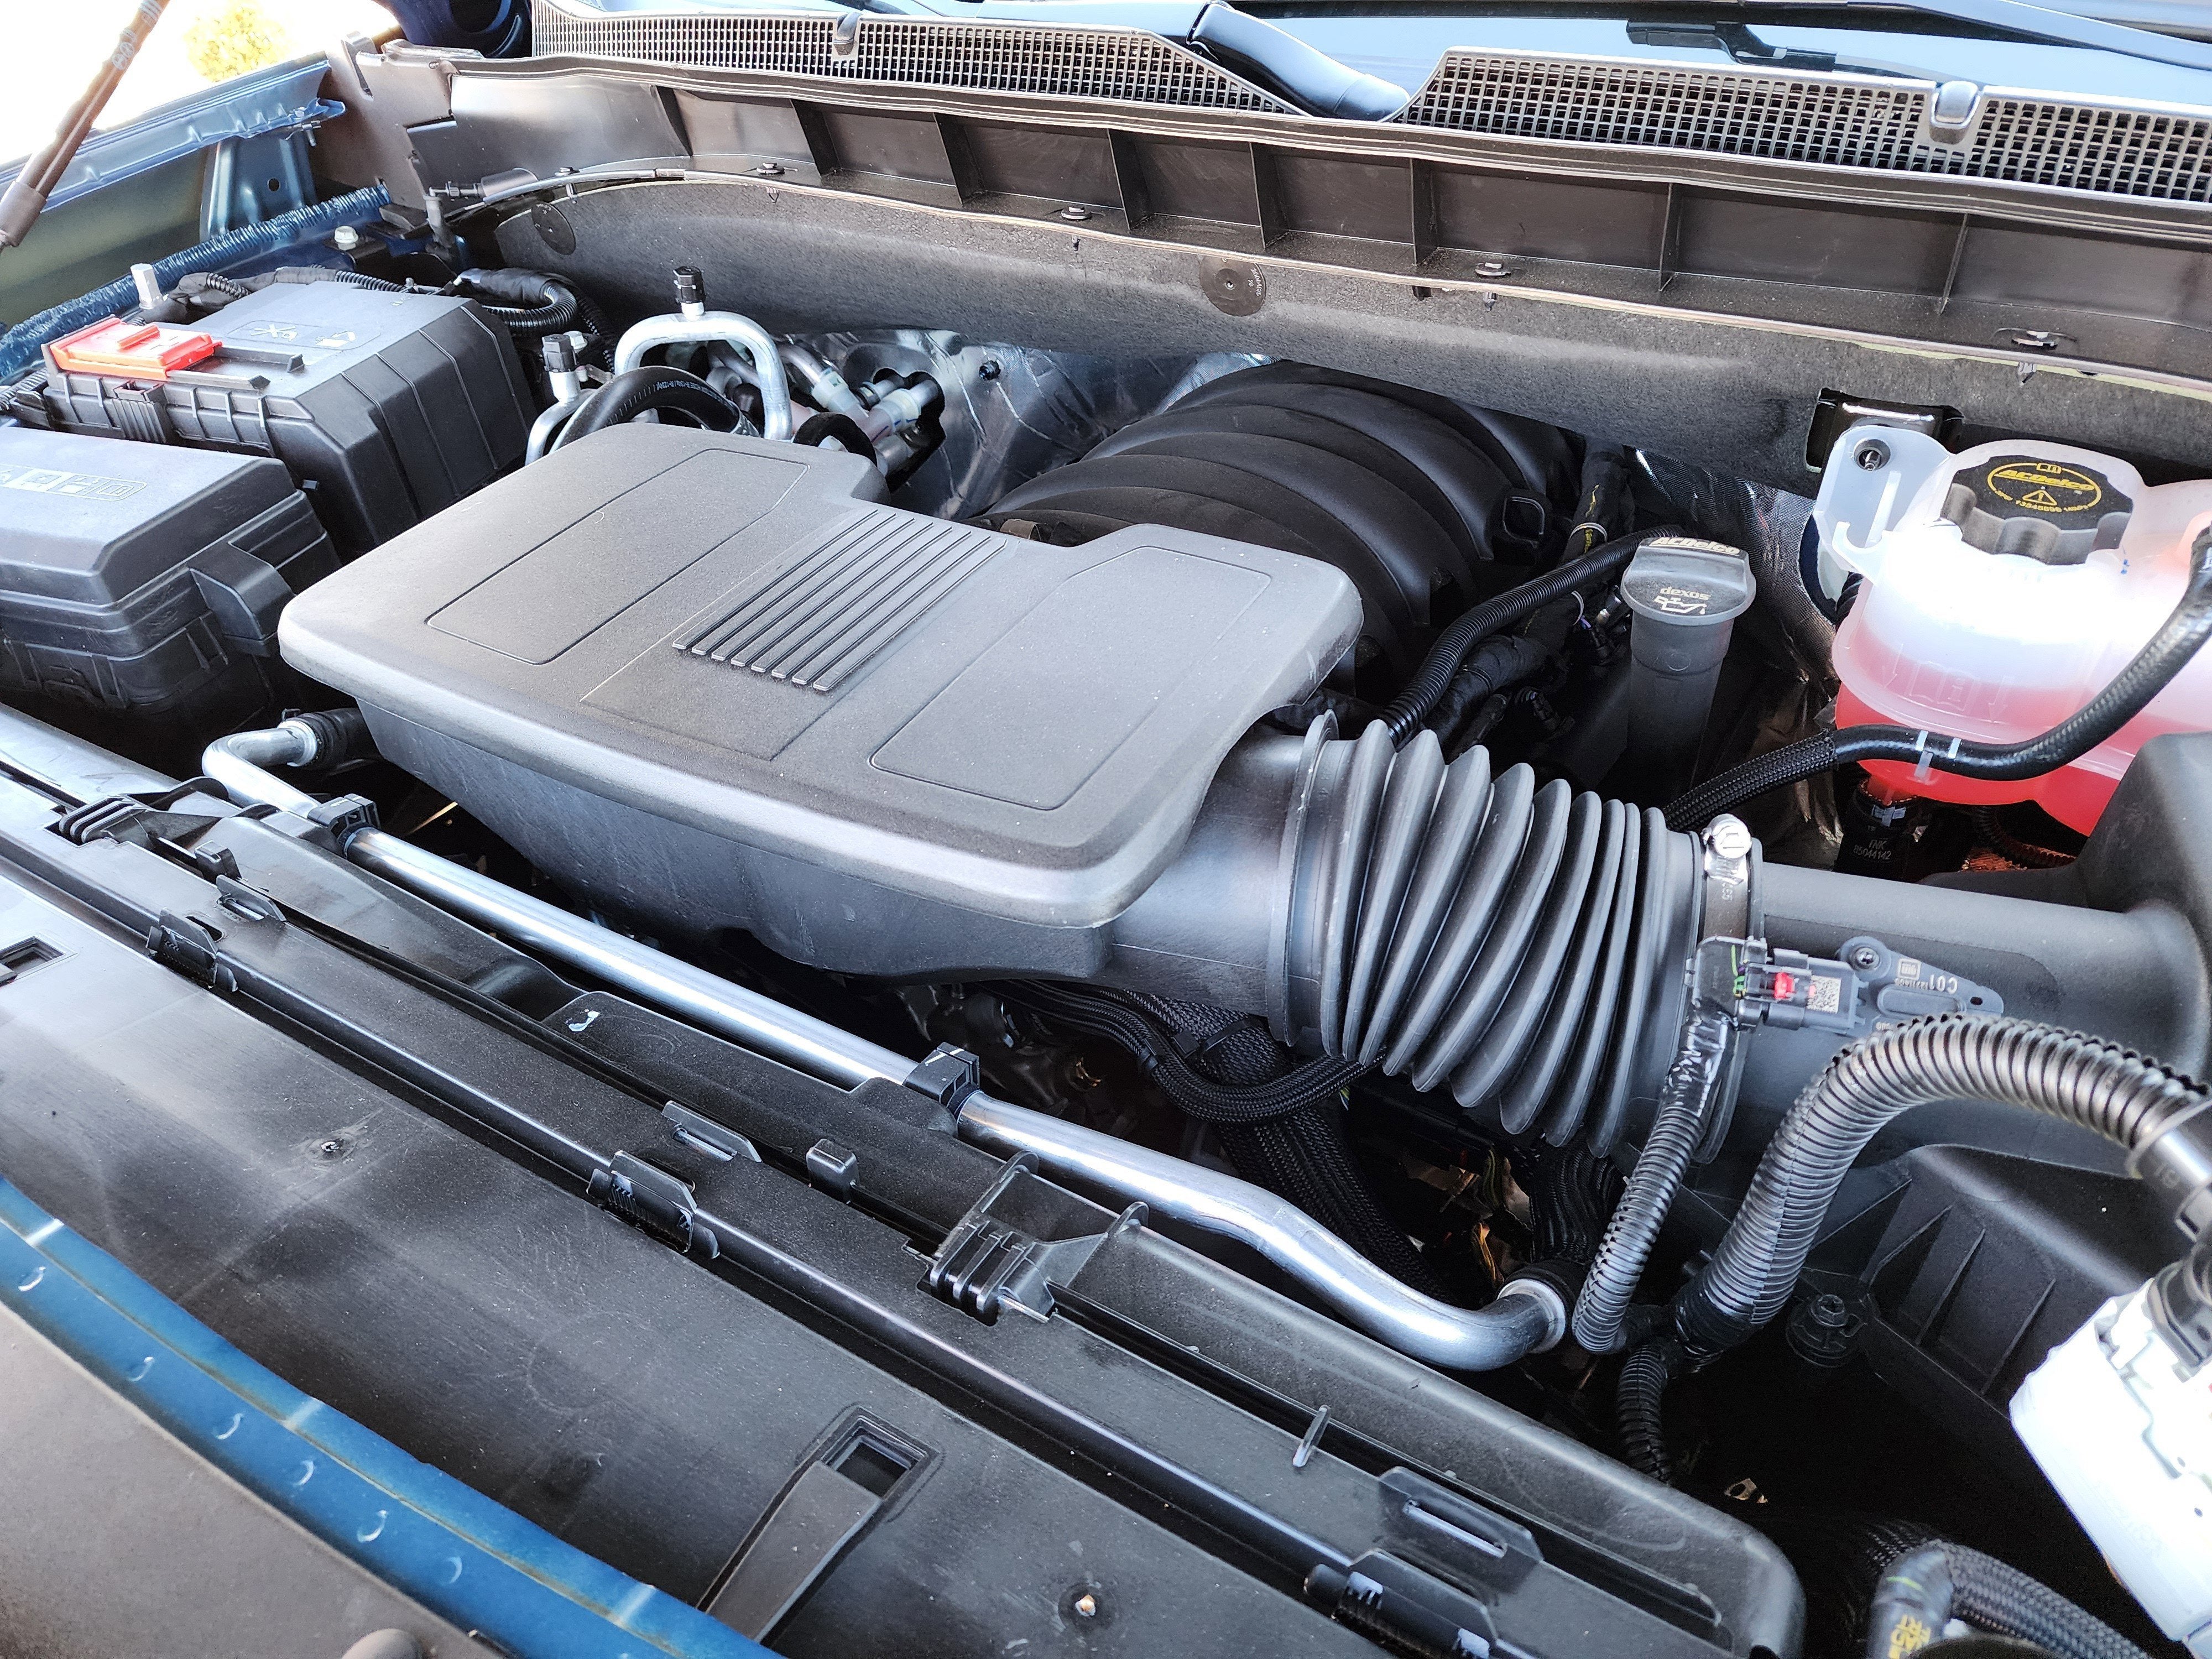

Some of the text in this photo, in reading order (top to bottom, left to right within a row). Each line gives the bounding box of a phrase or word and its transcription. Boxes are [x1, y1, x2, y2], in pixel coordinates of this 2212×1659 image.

[1998, 469, 2095, 491] ACDelco
[1651, 537, 1740, 555] ACDelco
[1660, 586, 1711, 601] dexos
